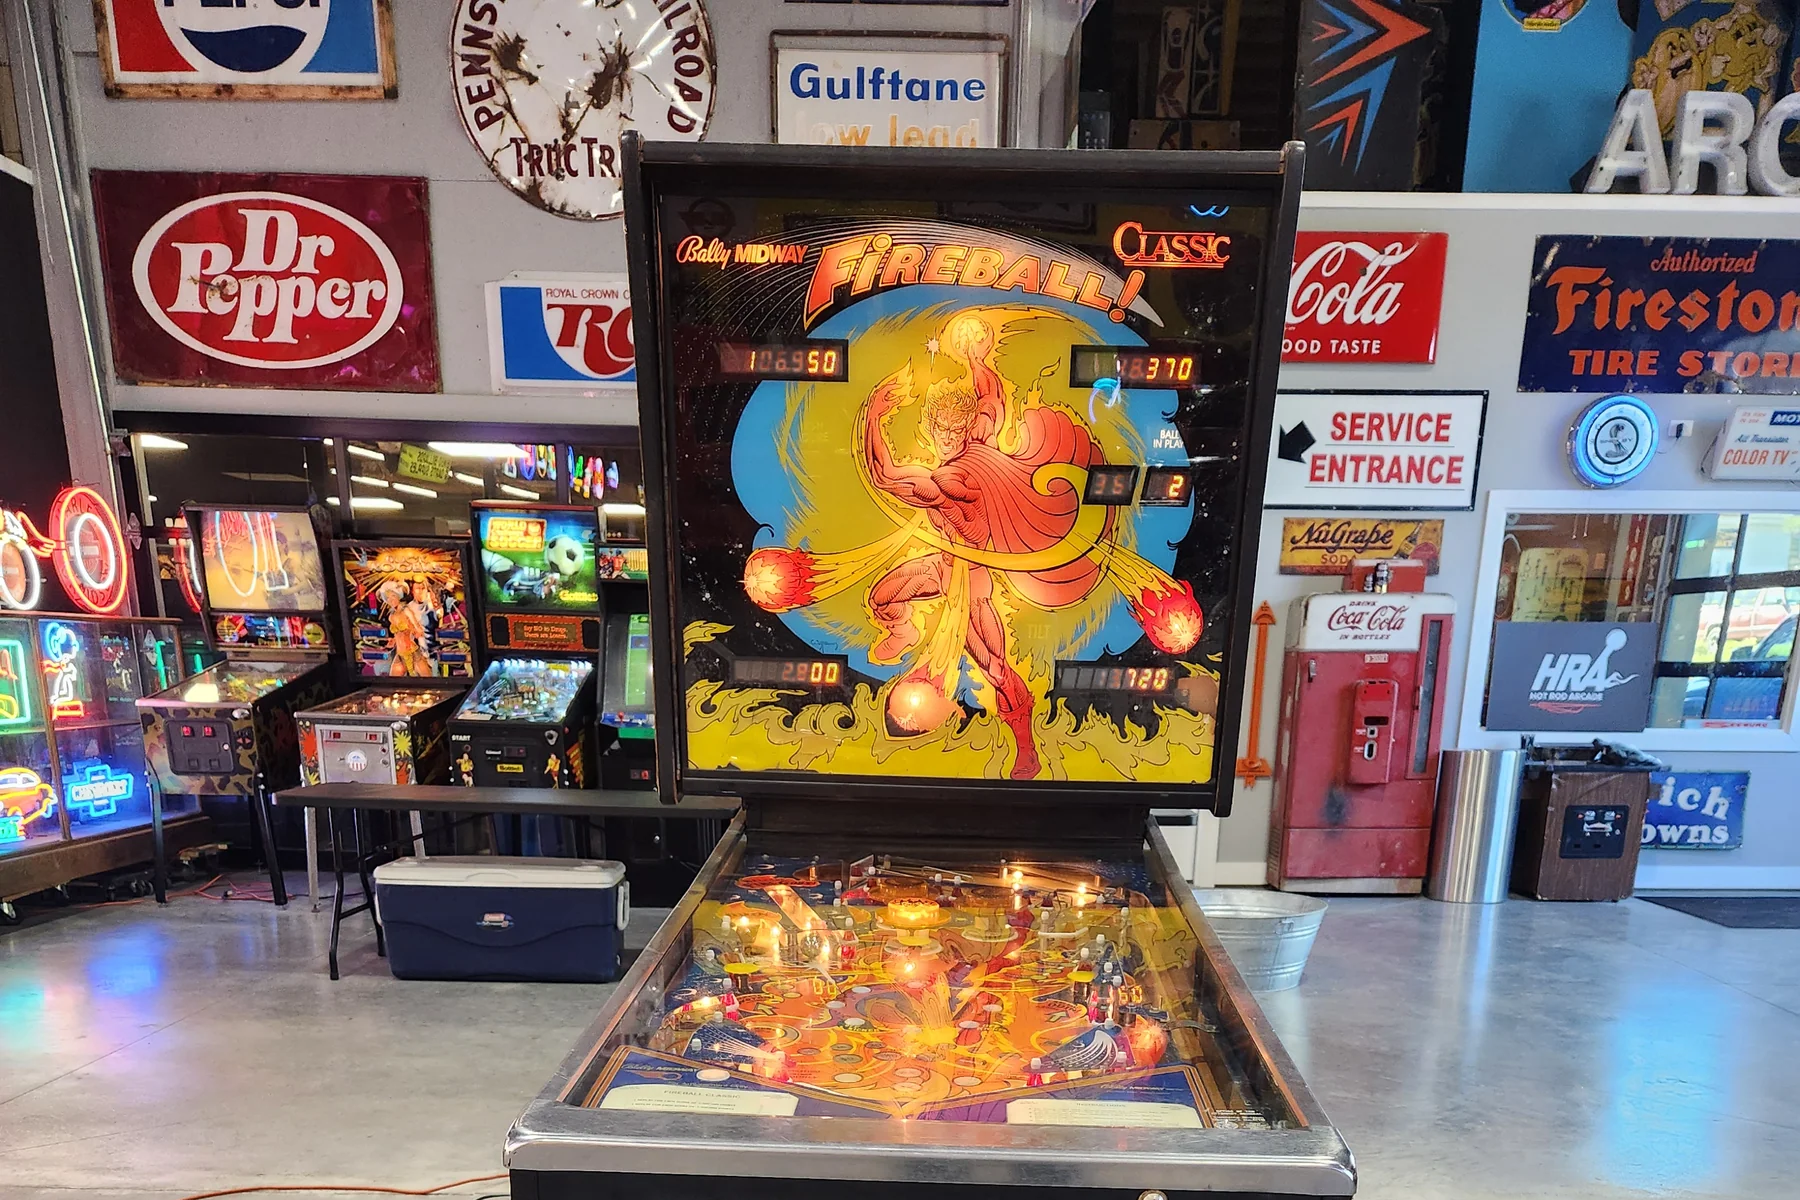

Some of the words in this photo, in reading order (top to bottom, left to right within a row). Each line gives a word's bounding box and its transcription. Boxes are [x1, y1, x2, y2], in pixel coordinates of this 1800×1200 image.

[790, 62, 986, 102] Gulftane
[889, 114, 979, 147] lead
[581, 137, 622, 178] TR
[232, 209, 335, 274] Dr
[675, 234, 732, 270] Bally
[734, 243, 808, 264] MIDWAY
[1651, 248, 1758, 273] Authorized
[166, 242, 387, 344] Pepper
[545, 288, 578, 299] ROYAL
[580, 288, 619, 300] CROWN
[1329, 339, 1382, 354] TASTE
[1569, 350, 1660, 376] TIRE
[1160, 430, 1180, 440] BALL
[1330, 411, 1453, 442] SERVICE
[1153, 439, 1162, 448] IN
[1164, 439, 1184, 449] PLAY
[1723, 448, 1769, 465] COLOR
[1772, 449, 1789, 465] TV
[1308, 453, 1464, 484] ENTRANCE
[1168, 474, 1184, 497] 2
[1290, 520, 1394, 553] NuGrape
